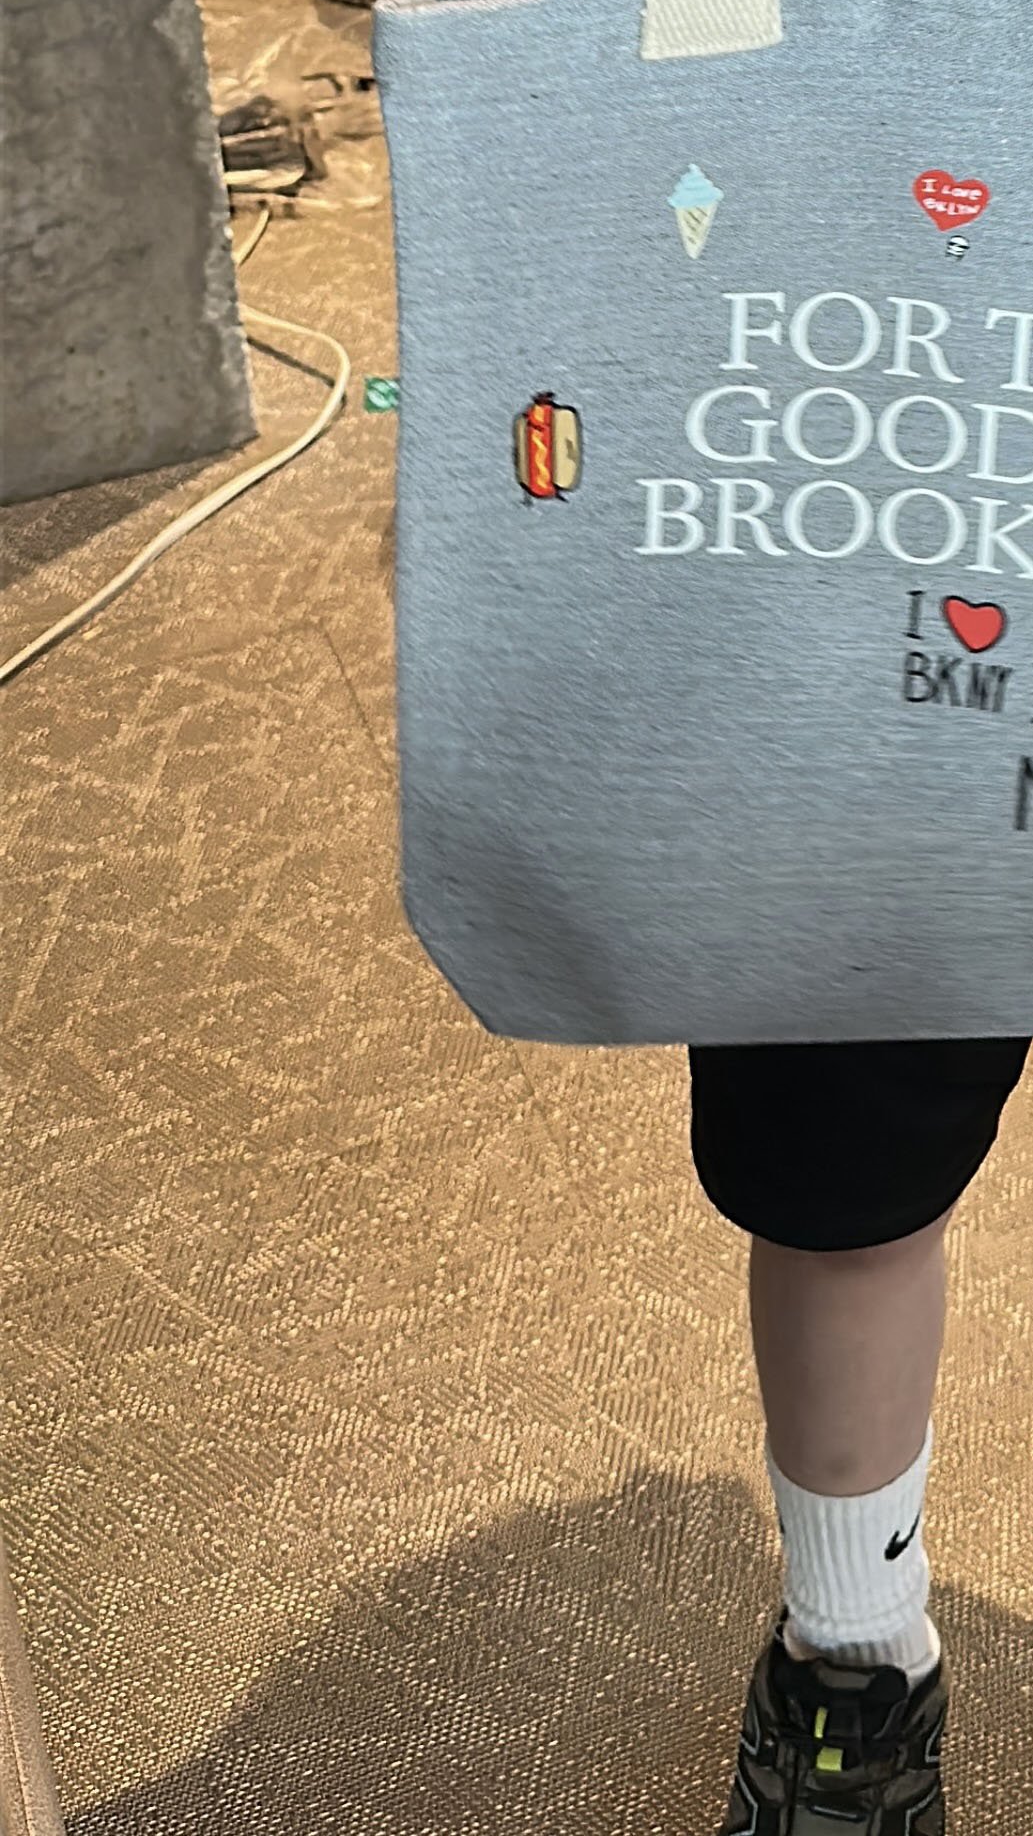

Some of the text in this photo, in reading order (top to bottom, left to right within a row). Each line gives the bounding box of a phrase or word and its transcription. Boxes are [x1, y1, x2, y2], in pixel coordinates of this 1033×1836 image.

[921, 178, 937, 193] I
[718, 290, 965, 385] FOR
[904, 590, 926, 640] I
